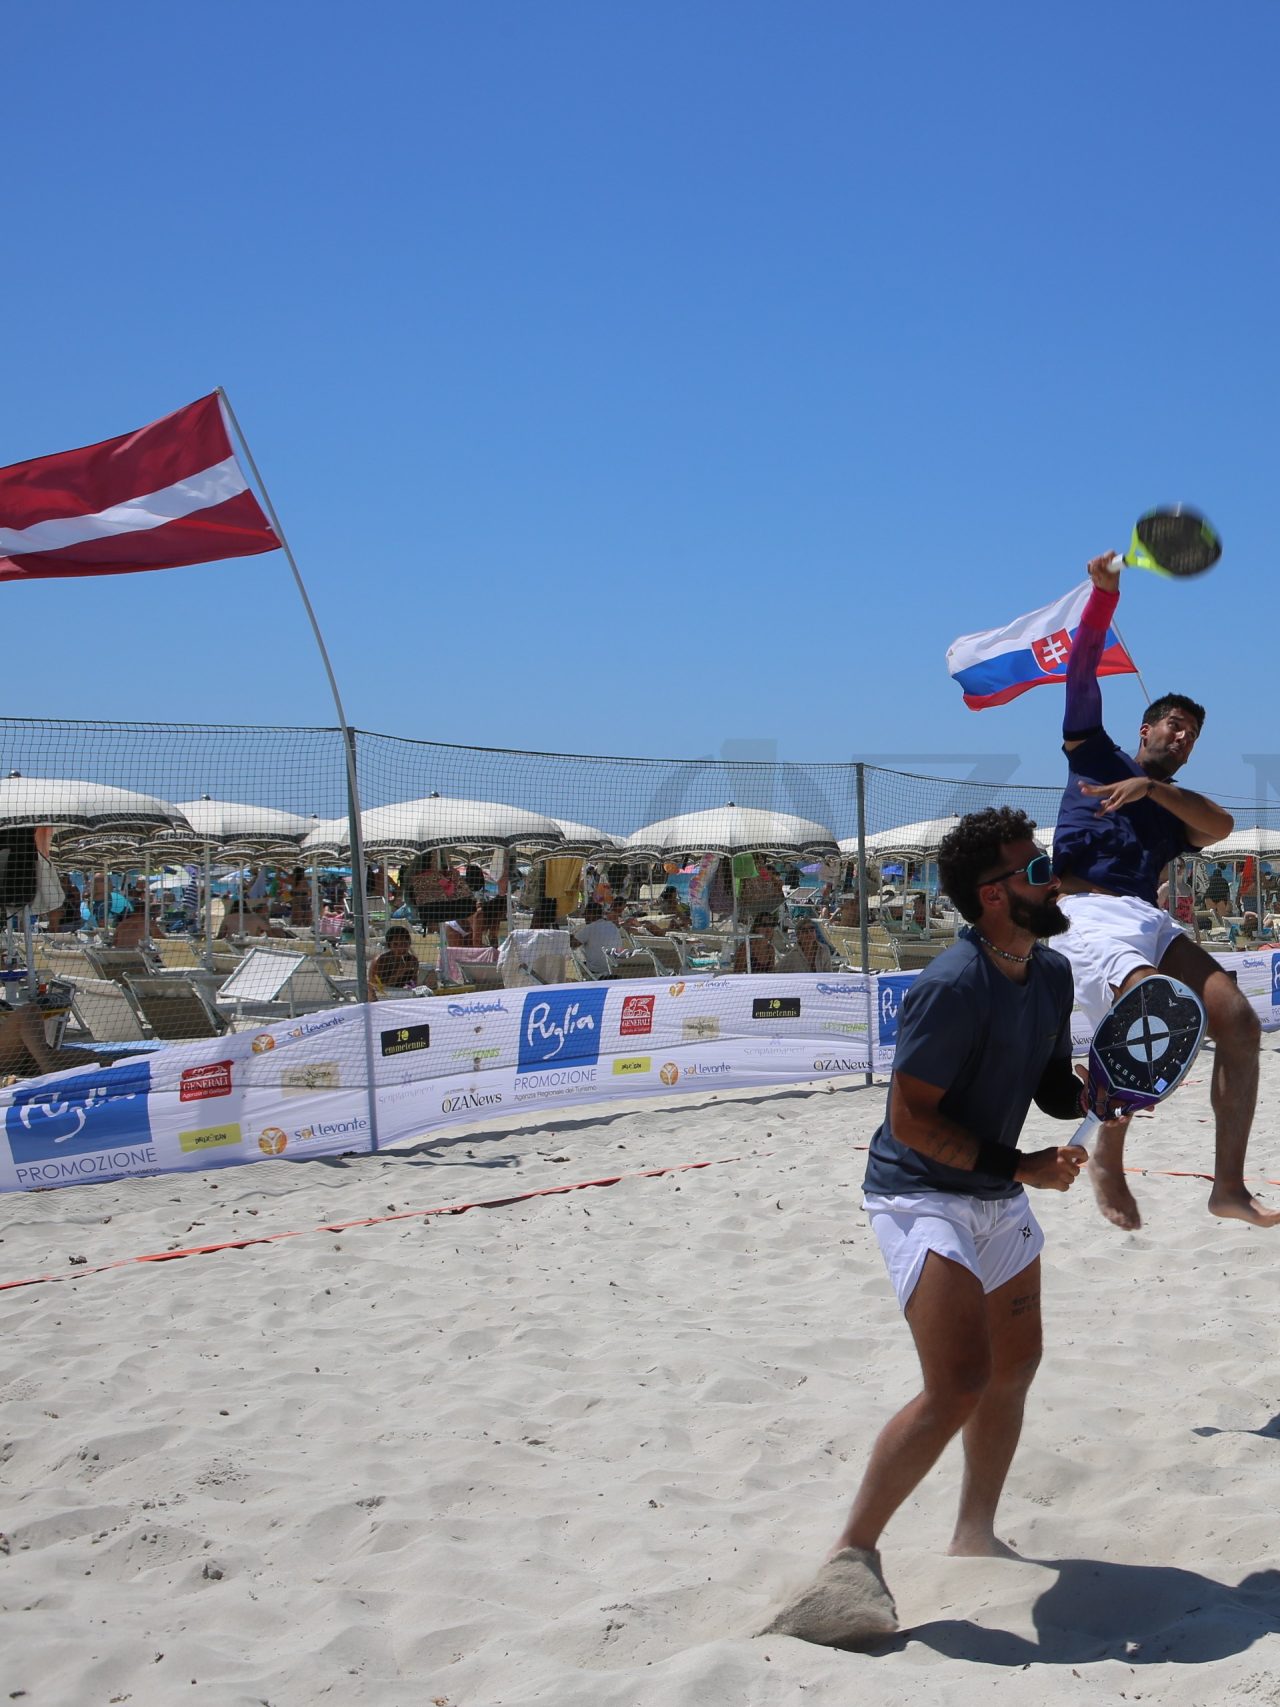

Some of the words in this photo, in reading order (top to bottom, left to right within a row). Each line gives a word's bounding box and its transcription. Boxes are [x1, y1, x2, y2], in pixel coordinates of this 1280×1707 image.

[755, 1008, 797, 1018] emmetennis
[306, 1015, 345, 1034] levante
[527, 1002, 594, 1060] Puglia
[622, 1018, 650, 1027] GENERALI
[384, 1037, 427, 1054] emmetennis
[698, 1062, 731, 1074] levante
[813, 1059, 873, 1071] OZANews
[183, 1076, 229, 1091] GENERALI
[514, 1069, 597, 1091] PROMOZIONE
[537, 1089, 565, 1099] Regionale
[441, 1093, 502, 1113] OZANews
[295, 1124, 315, 1140] sol
[318, 1117, 367, 1135] levante
[16, 1147, 158, 1183] PROMOZIONE
